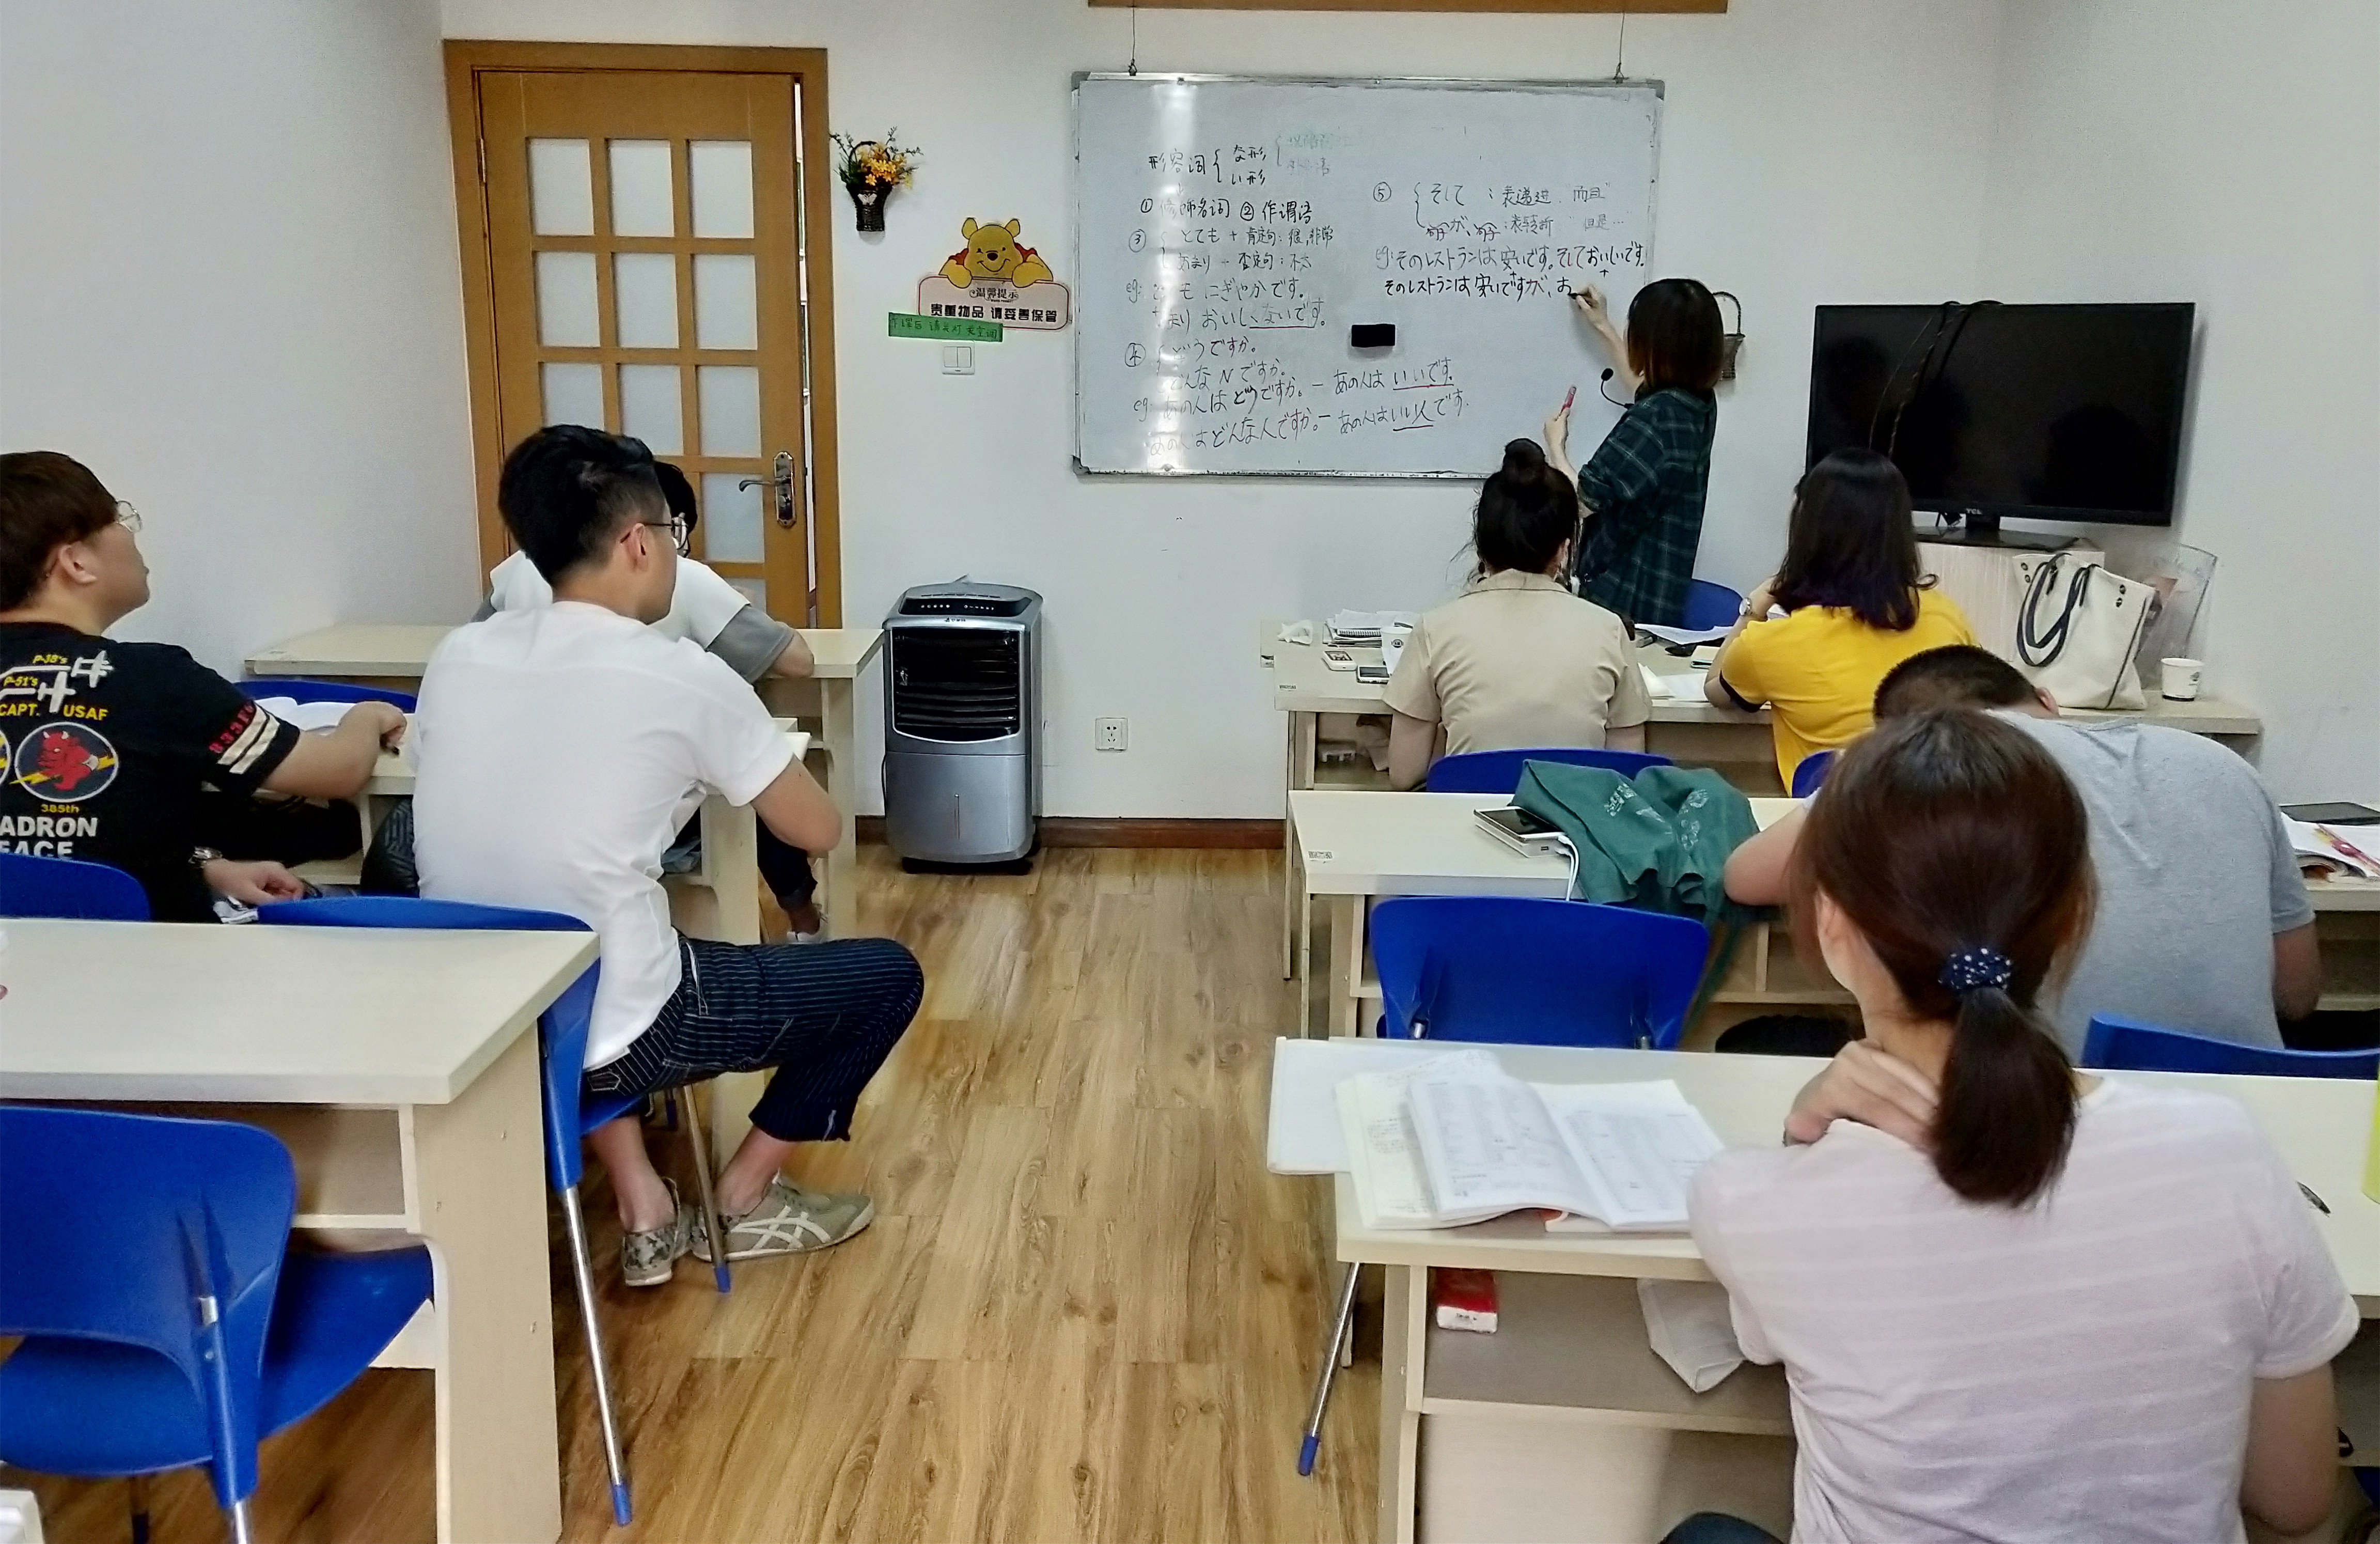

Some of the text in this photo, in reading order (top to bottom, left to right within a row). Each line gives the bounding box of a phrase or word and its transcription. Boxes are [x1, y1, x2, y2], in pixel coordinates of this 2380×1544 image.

[1149, 148, 1205, 175] 形容词
[1233, 144, 1266, 162] な形
[1231, 169, 1265, 186] い形
[1431, 183, 1464, 206] そして
[1181, 228, 1220, 243] とても
[931, 304, 1057, 322] 贵重物品 请妥善保管
[3, 676, 38, 687] P-51's
[0, 703, 108, 721] CAPT. USAF
[40, 804, 80, 813] 385th
